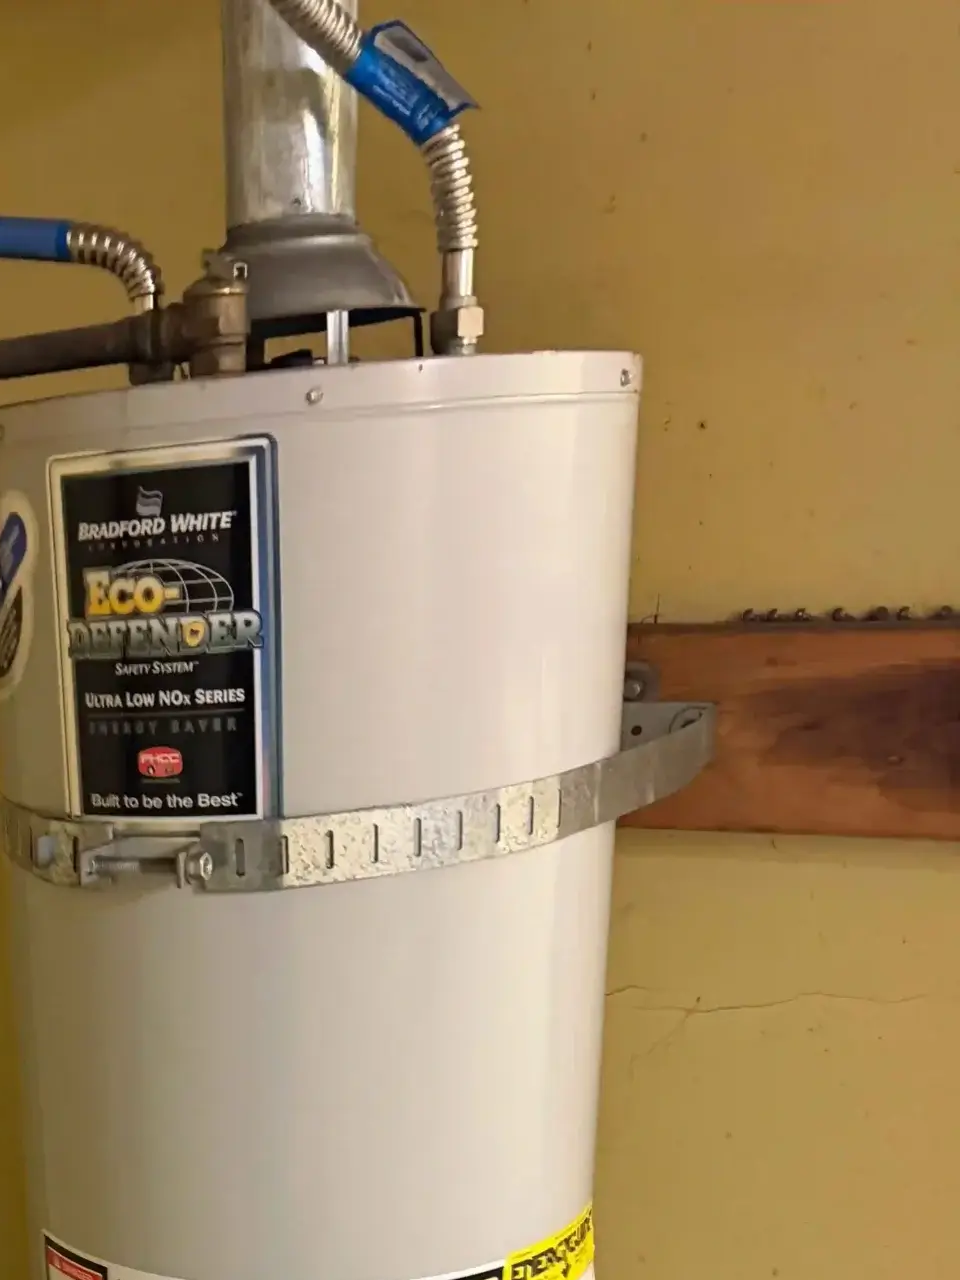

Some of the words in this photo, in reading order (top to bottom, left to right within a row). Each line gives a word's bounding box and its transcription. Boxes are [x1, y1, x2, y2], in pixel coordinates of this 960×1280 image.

[78, 518, 165, 542] BRADFORD
[170, 512, 232, 533] WHITE
[115, 662, 151, 676] SAFETY
[152, 660, 194, 675] SYSTEM
[85, 692, 123, 708] ULTRA
[125, 692, 156, 708] LOW
[194, 688, 245, 705] SERIES
[91, 793, 121, 809] Built
[123, 794, 140, 809] to
[142, 793, 163, 810] be
[167, 793, 193, 809] the
[197, 792, 239, 808] Best
